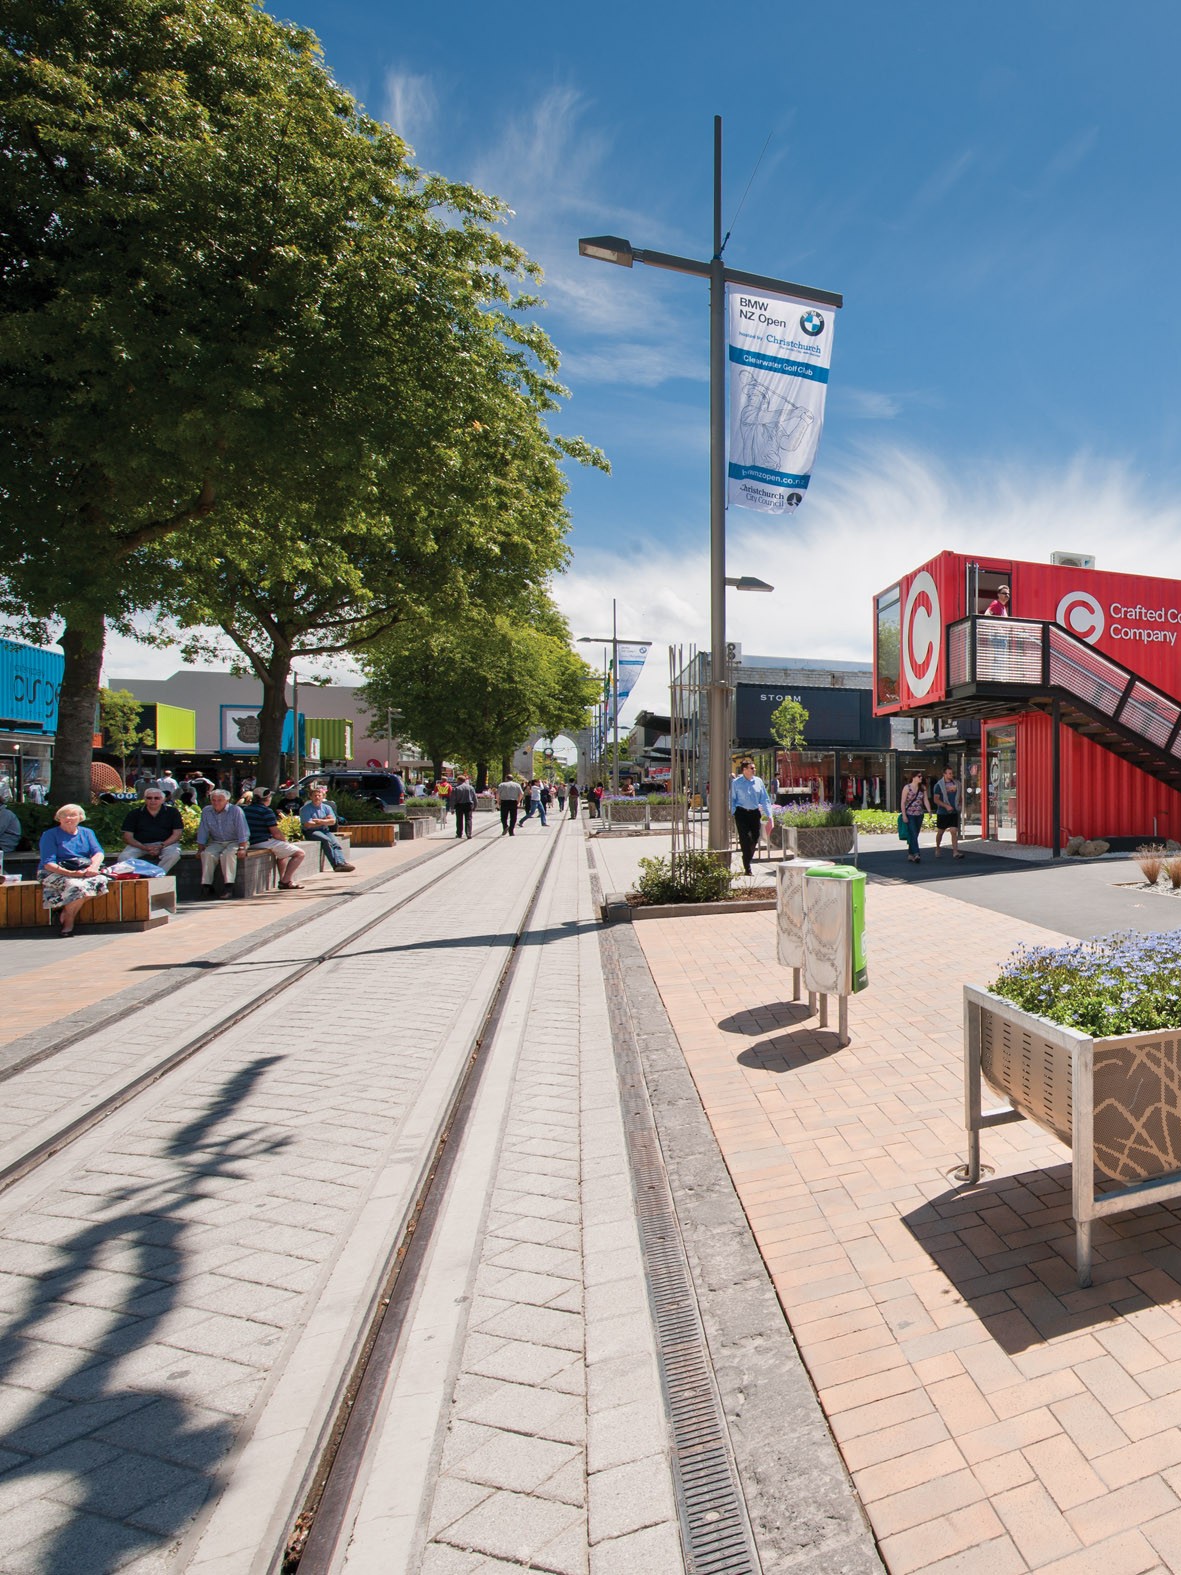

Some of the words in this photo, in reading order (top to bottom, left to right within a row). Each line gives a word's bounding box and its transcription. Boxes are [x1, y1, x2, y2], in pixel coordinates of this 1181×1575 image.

[740, 297, 768, 311] BMW
[739, 309, 755, 321] NZ
[758, 313, 786, 328] Open
[766, 334, 821, 354] Christchurch
[743, 354, 782, 369] Clearwater
[782, 363, 797, 372] Golf
[797, 367, 814, 376] Club
[745, 493, 757, 503] City
[758, 496, 784, 507] Council
[1110, 603, 1165, 622] Crafted
[1110, 624, 1177, 646] Company
